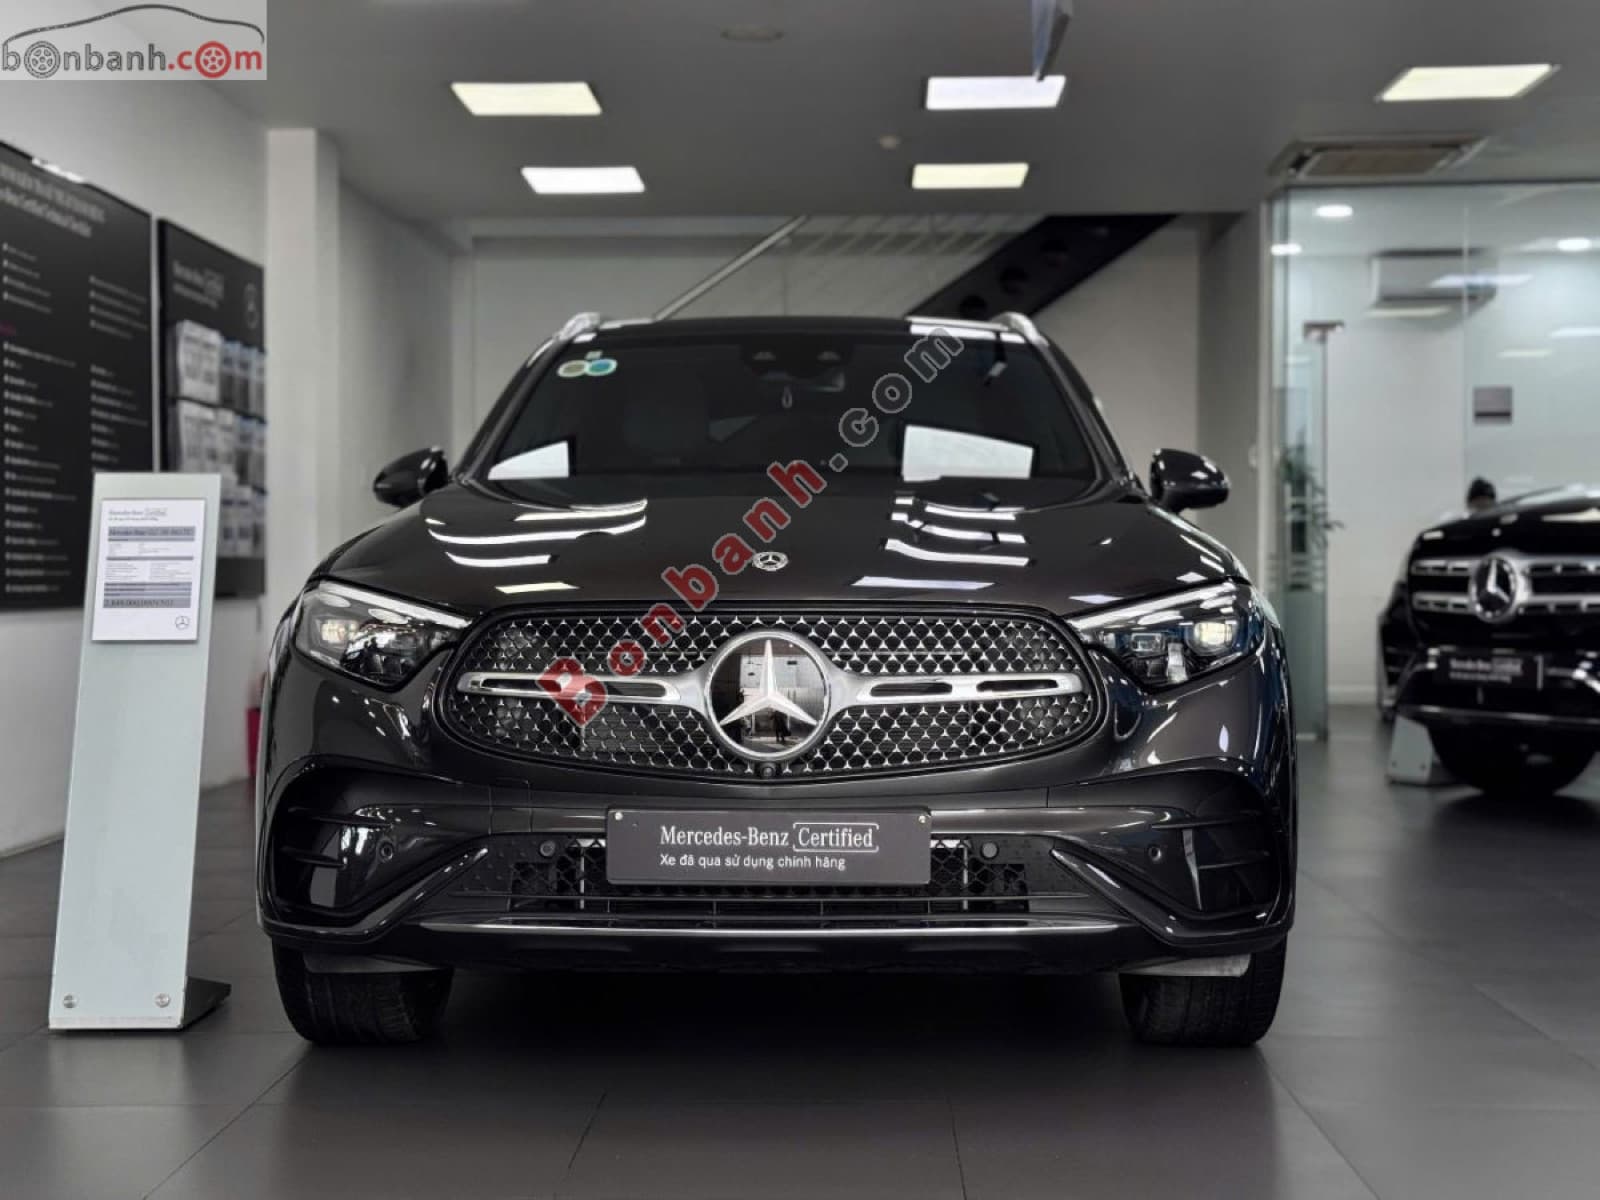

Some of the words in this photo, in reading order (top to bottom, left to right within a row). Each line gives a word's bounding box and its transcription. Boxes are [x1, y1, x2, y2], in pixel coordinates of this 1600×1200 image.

[660, 825, 789, 846] Mercedes-Benz
[798, 827, 873, 848] Certified
[660, 853, 676, 866] Xe
[679, 853, 695, 866] đã
[698, 856, 721, 869] qua
[724, 853, 741, 866] sử
[743, 855, 774, 870] dụng
